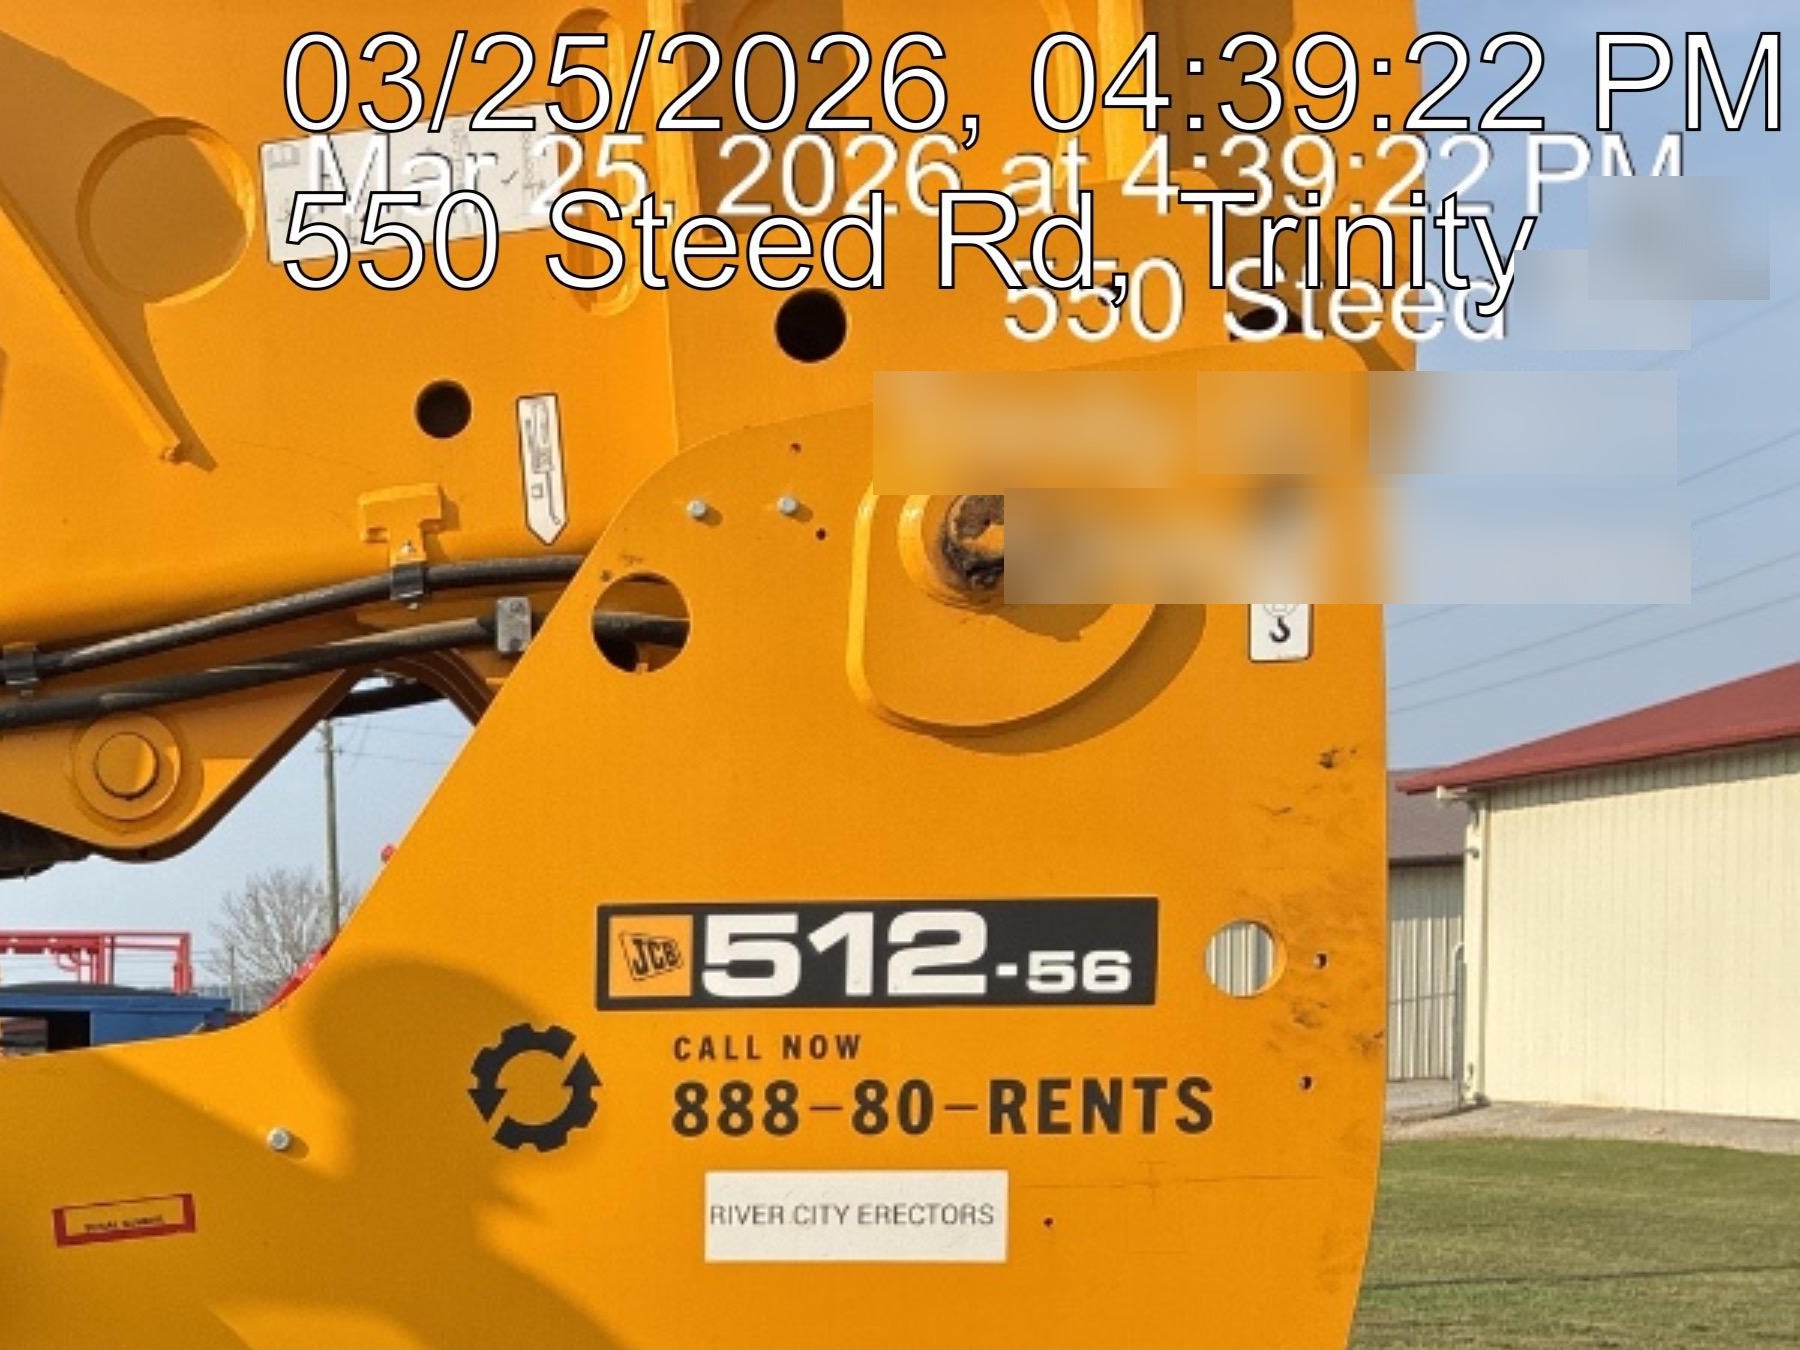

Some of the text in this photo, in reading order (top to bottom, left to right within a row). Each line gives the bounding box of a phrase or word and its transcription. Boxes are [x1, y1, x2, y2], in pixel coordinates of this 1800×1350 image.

[631, 910, 1133, 998] JCB 512-56
[672, 1034, 863, 1062] CALL NOW
[671, 1076, 1214, 1137] 888-80-RENTS
[709, 1202, 997, 1226] RIVER CITY ERECTORS
